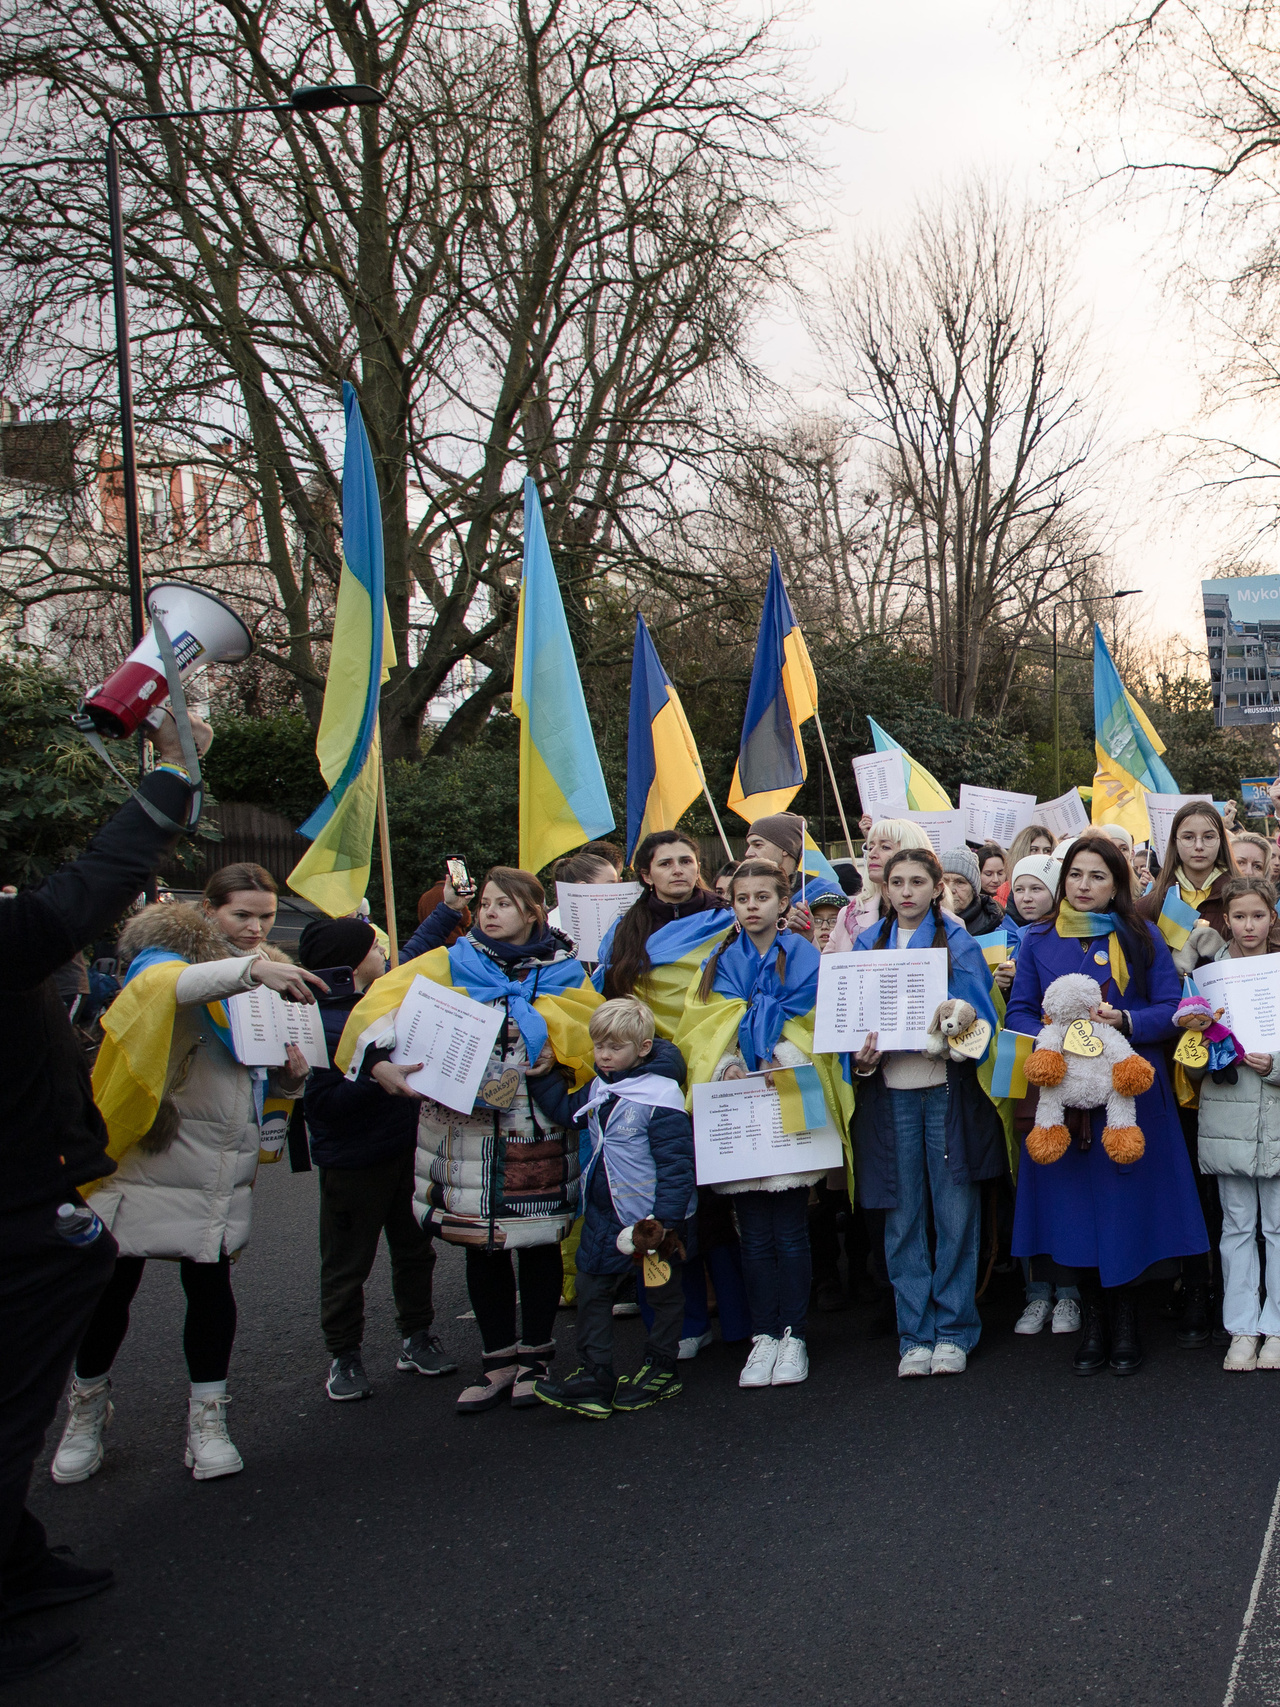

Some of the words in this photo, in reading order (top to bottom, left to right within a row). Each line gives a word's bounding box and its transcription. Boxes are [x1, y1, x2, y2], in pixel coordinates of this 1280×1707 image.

[177, 636, 194, 650] WITH
[176, 642, 202, 669] KRAINE
[952, 1026, 986, 1045] Tymur
[1072, 1021, 1096, 1053] Denys
[1188, 1036, 1202, 1061] Kyryl
[484, 1075, 518, 1099] Maksym
[261, 1128, 286, 1136] SUPPORT
